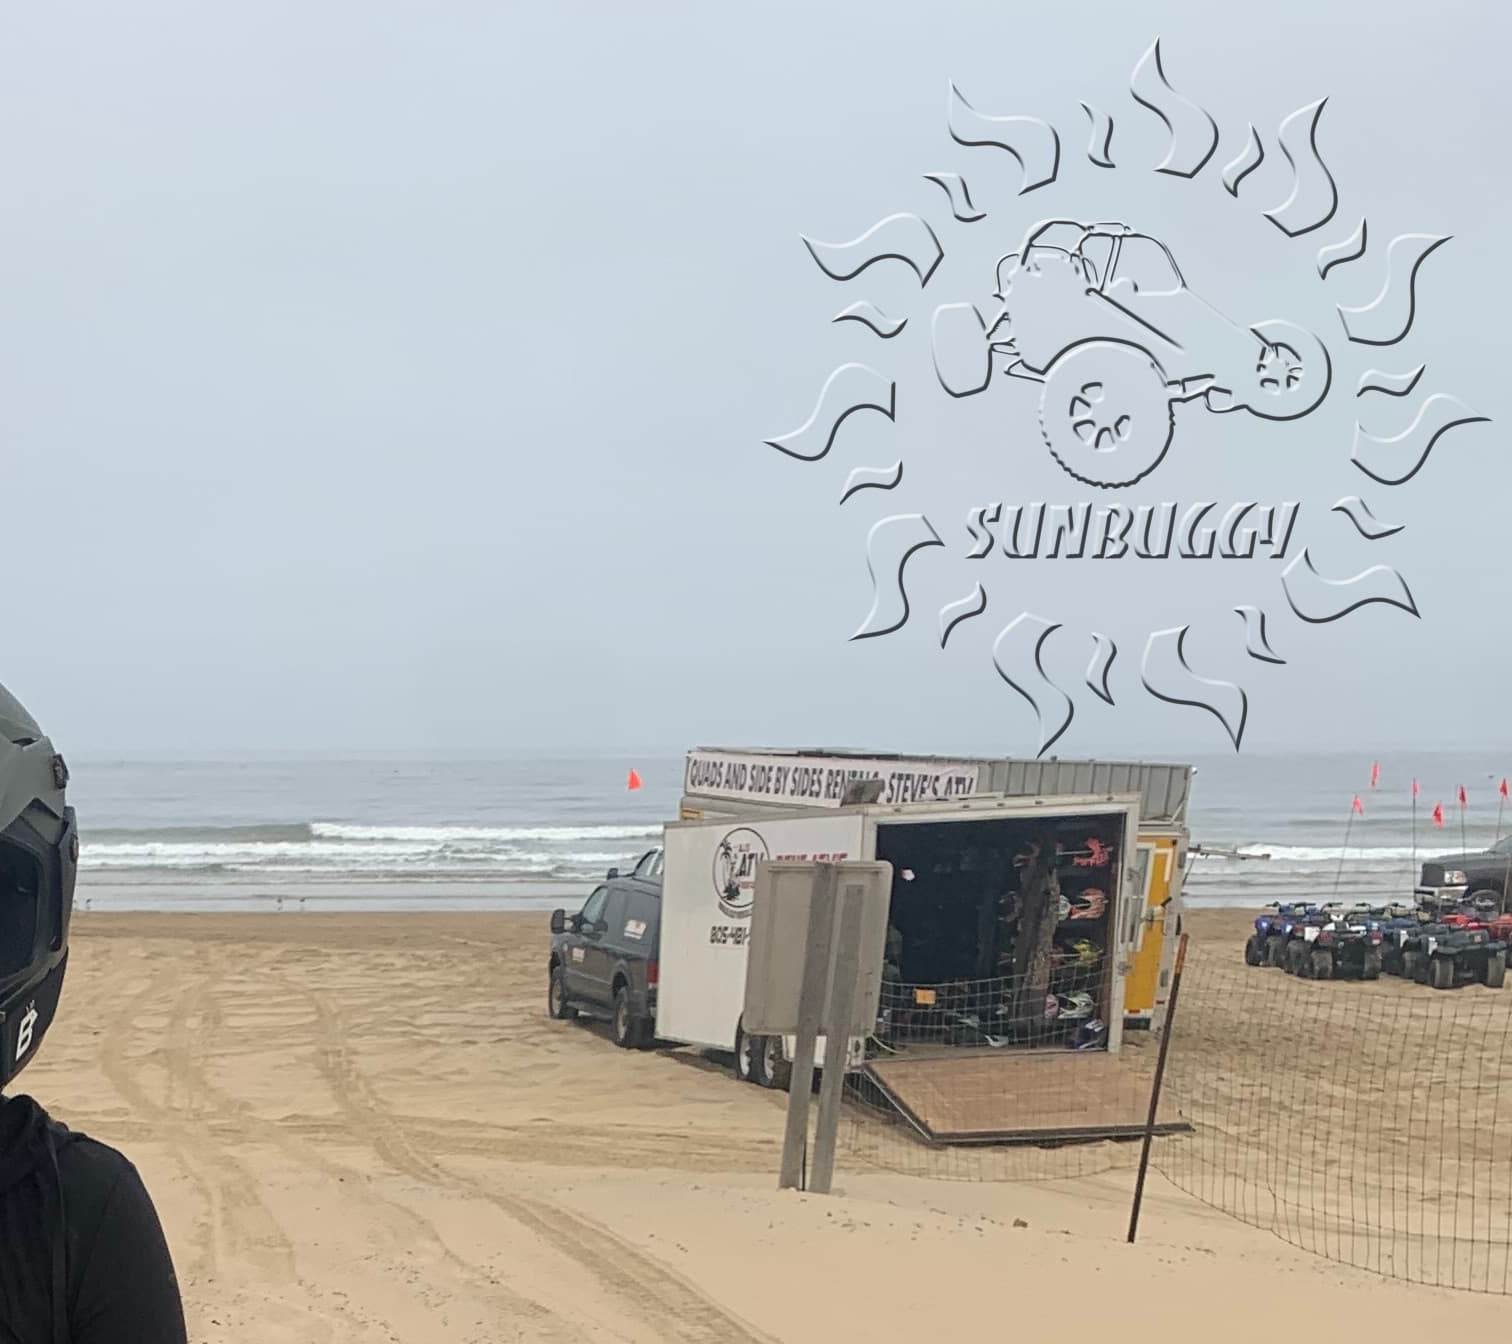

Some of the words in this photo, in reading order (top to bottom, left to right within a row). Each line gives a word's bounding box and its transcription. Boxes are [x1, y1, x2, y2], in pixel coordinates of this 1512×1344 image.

[690, 759, 724, 788] QUADS
[723, 763, 748, 791] AND
[748, 764, 773, 794] SIDE
[774, 766, 790, 795] BY
[790, 767, 824, 799] SIDES
[886, 772, 940, 803] STEVE'S
